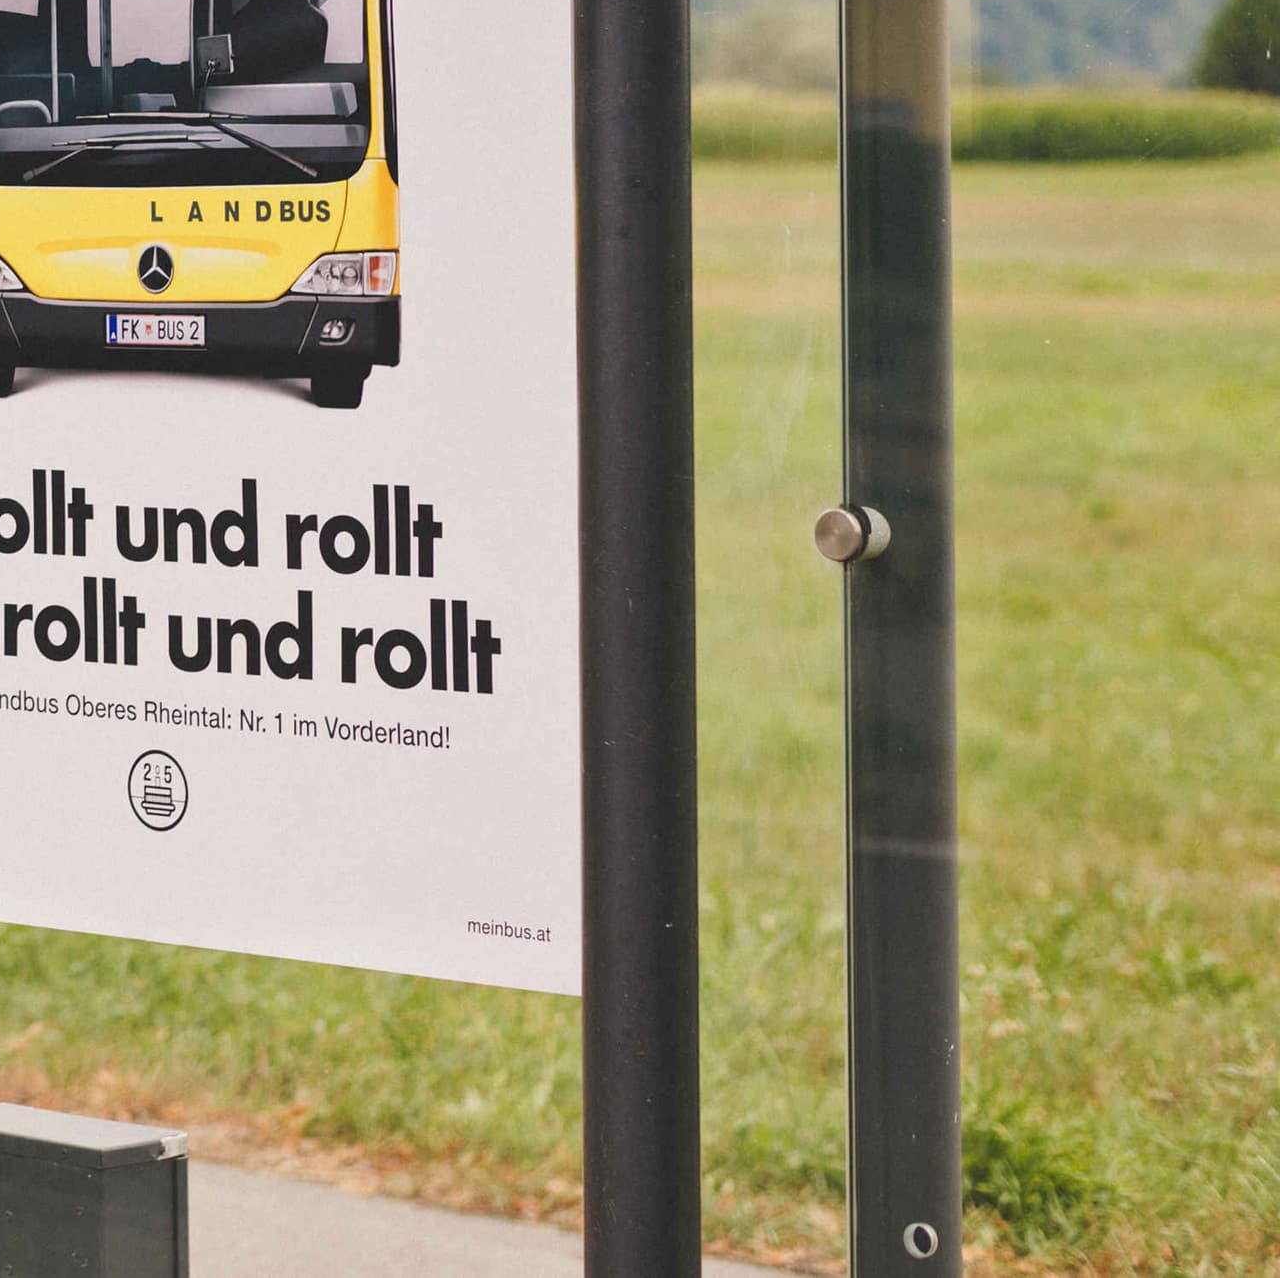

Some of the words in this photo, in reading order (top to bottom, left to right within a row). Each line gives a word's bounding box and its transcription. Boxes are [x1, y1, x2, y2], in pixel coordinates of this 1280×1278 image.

[151, 200, 331, 222] LANDBUS
[121, 319, 139, 339] FK
[158, 320, 184, 340] BUS
[190, 321, 199, 339] 2
[116, 478, 259, 567] und
[286, 484, 443, 578] rollt
[3, 576, 146, 666] rollt
[168, 590, 314, 680] und
[340, 598, 502, 694] rollt
[65, 694, 137, 721] Oberes
[144, 701, 232, 729] Rheintal:
[239, 708, 266, 733] Nr.
[274, 713, 284, 734] 1
[293, 713, 317, 737] im
[324, 716, 450, 749] Vorderland!
[467, 919, 551, 942] meinbus.at
